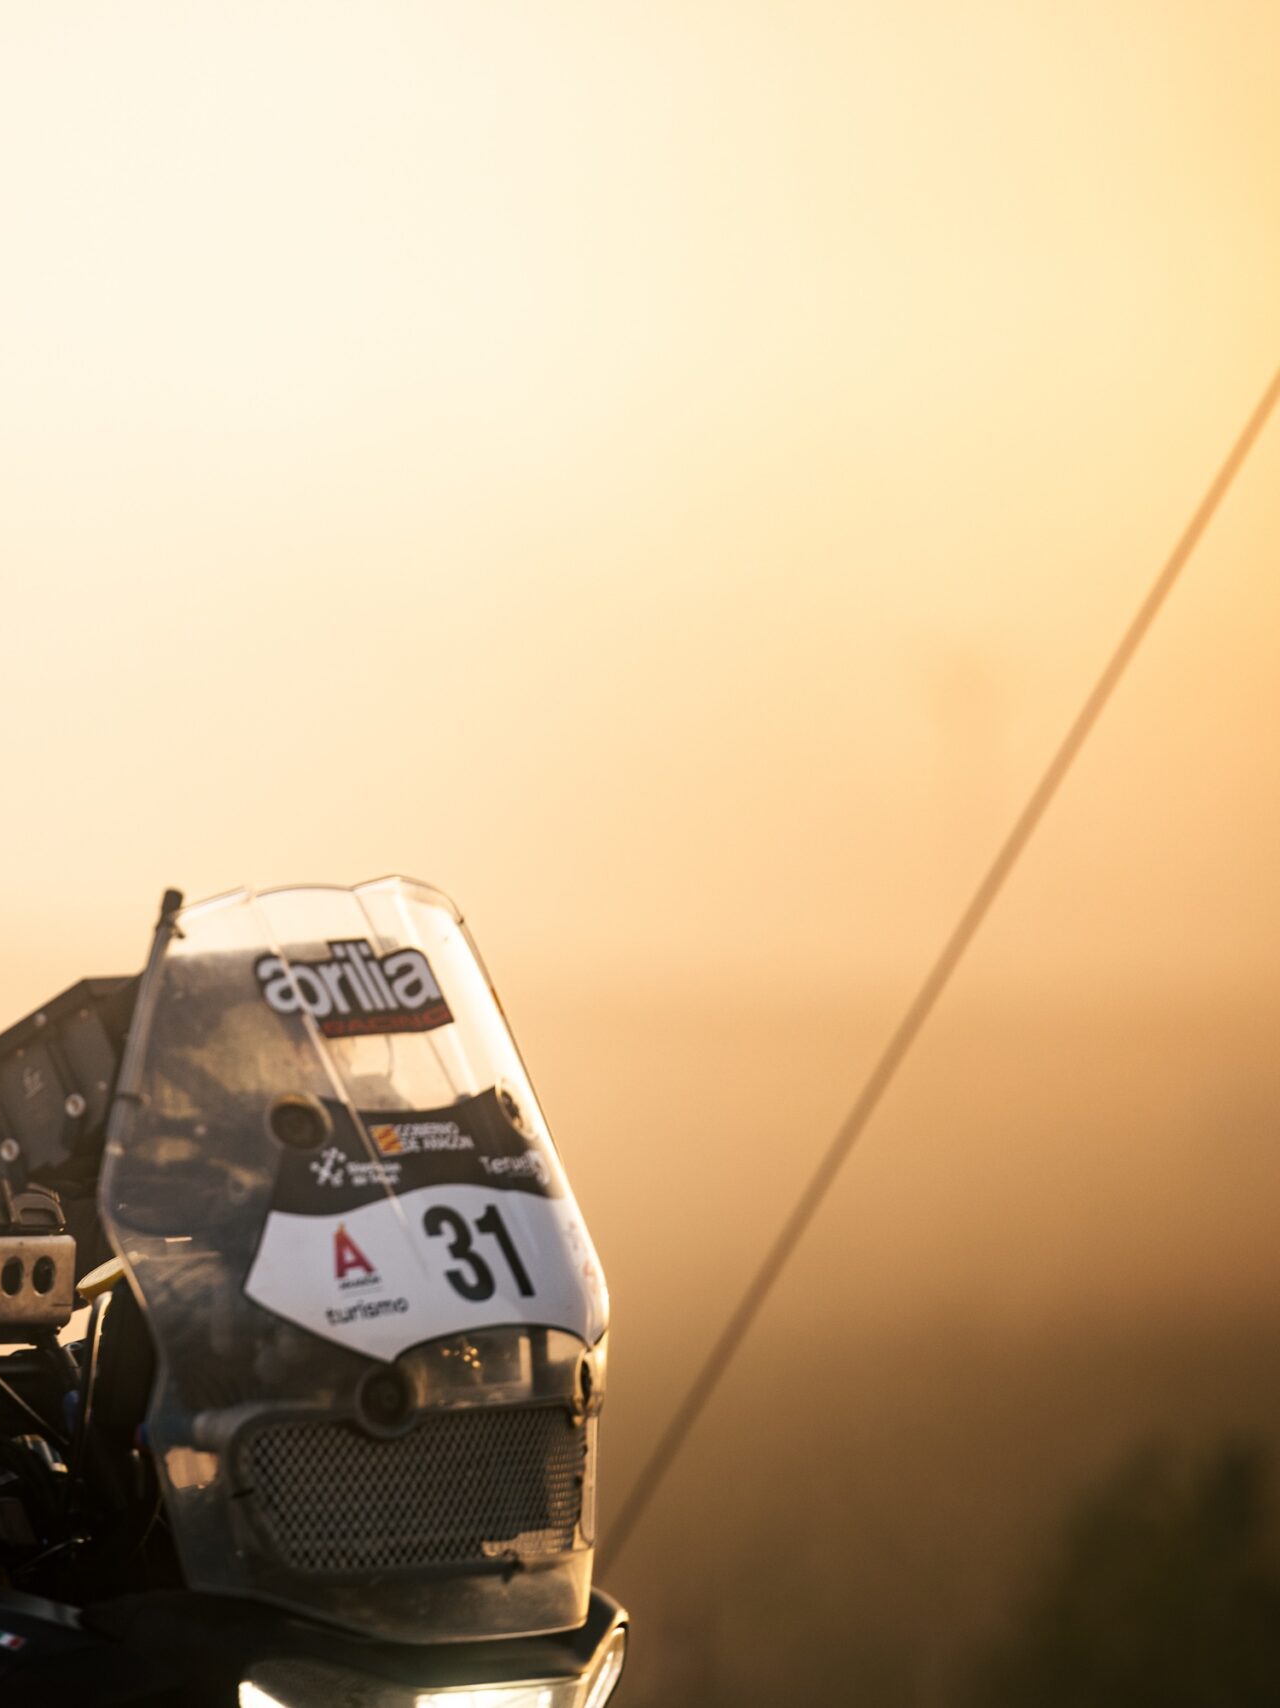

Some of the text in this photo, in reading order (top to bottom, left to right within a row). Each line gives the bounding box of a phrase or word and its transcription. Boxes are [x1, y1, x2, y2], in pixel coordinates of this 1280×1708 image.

[257, 942, 442, 1018] aprilia
[422, 1203, 536, 1302] 31
[325, 1297, 410, 1326] turismo
